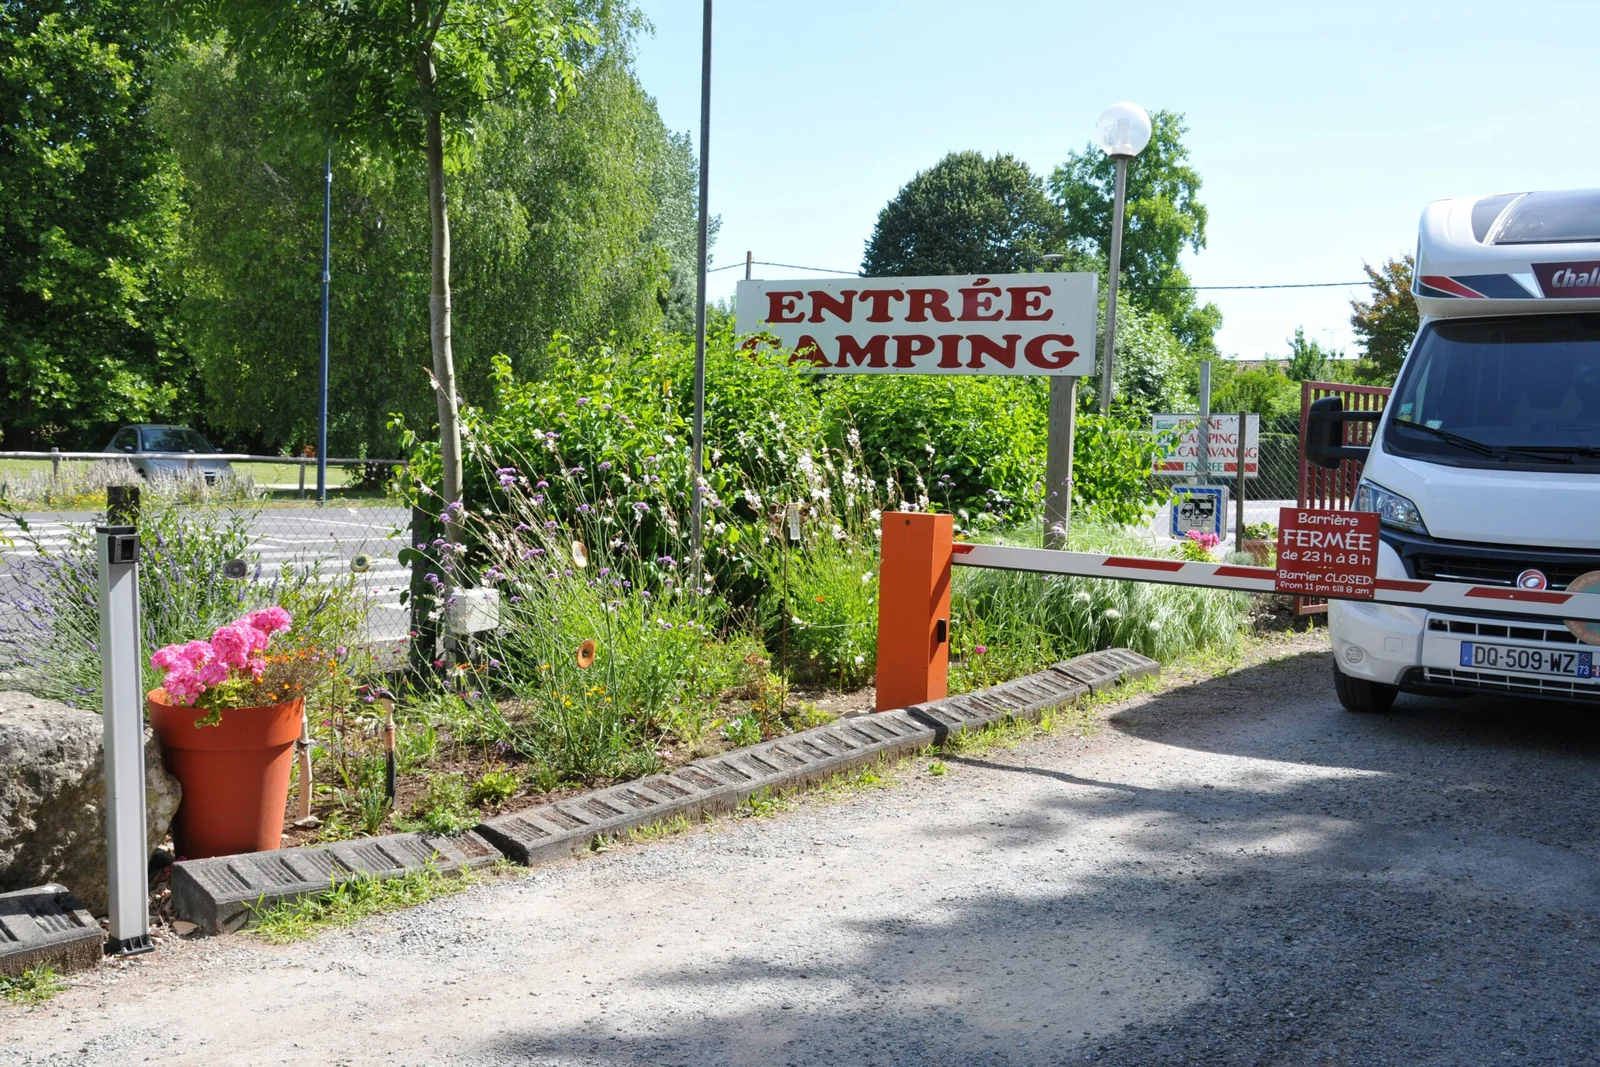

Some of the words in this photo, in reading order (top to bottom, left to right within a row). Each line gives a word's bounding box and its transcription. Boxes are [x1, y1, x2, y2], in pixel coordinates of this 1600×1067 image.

[764, 277, 1054, 324] ENTRÉE
[1178, 432, 1237, 445] CAPING
[1185, 462, 1223, 472] ENREE
[1298, 512, 1359, 526] Barrière
[1283, 529, 1372, 551] FERMÉE
[1281, 549, 1298, 560] de
[1301, 550, 1320, 562] 23
[1323, 552, 1332, 563] h
[1335, 553, 1346, 564] à
[1348, 554, 1358, 565] 8
[1362, 554, 1371, 565] h
[1279, 569, 1322, 581] Barrier
[1280, 580, 1303, 589] from
[1305, 582, 1314, 591] 11
[1315, 584, 1330, 592] pm
[1332, 585, 1344, 593] till
[1354, 587, 1369, 595] am
[1474, 645, 1576, 674] DQ-509-WZ
[1579, 665, 1589, 675] 73
